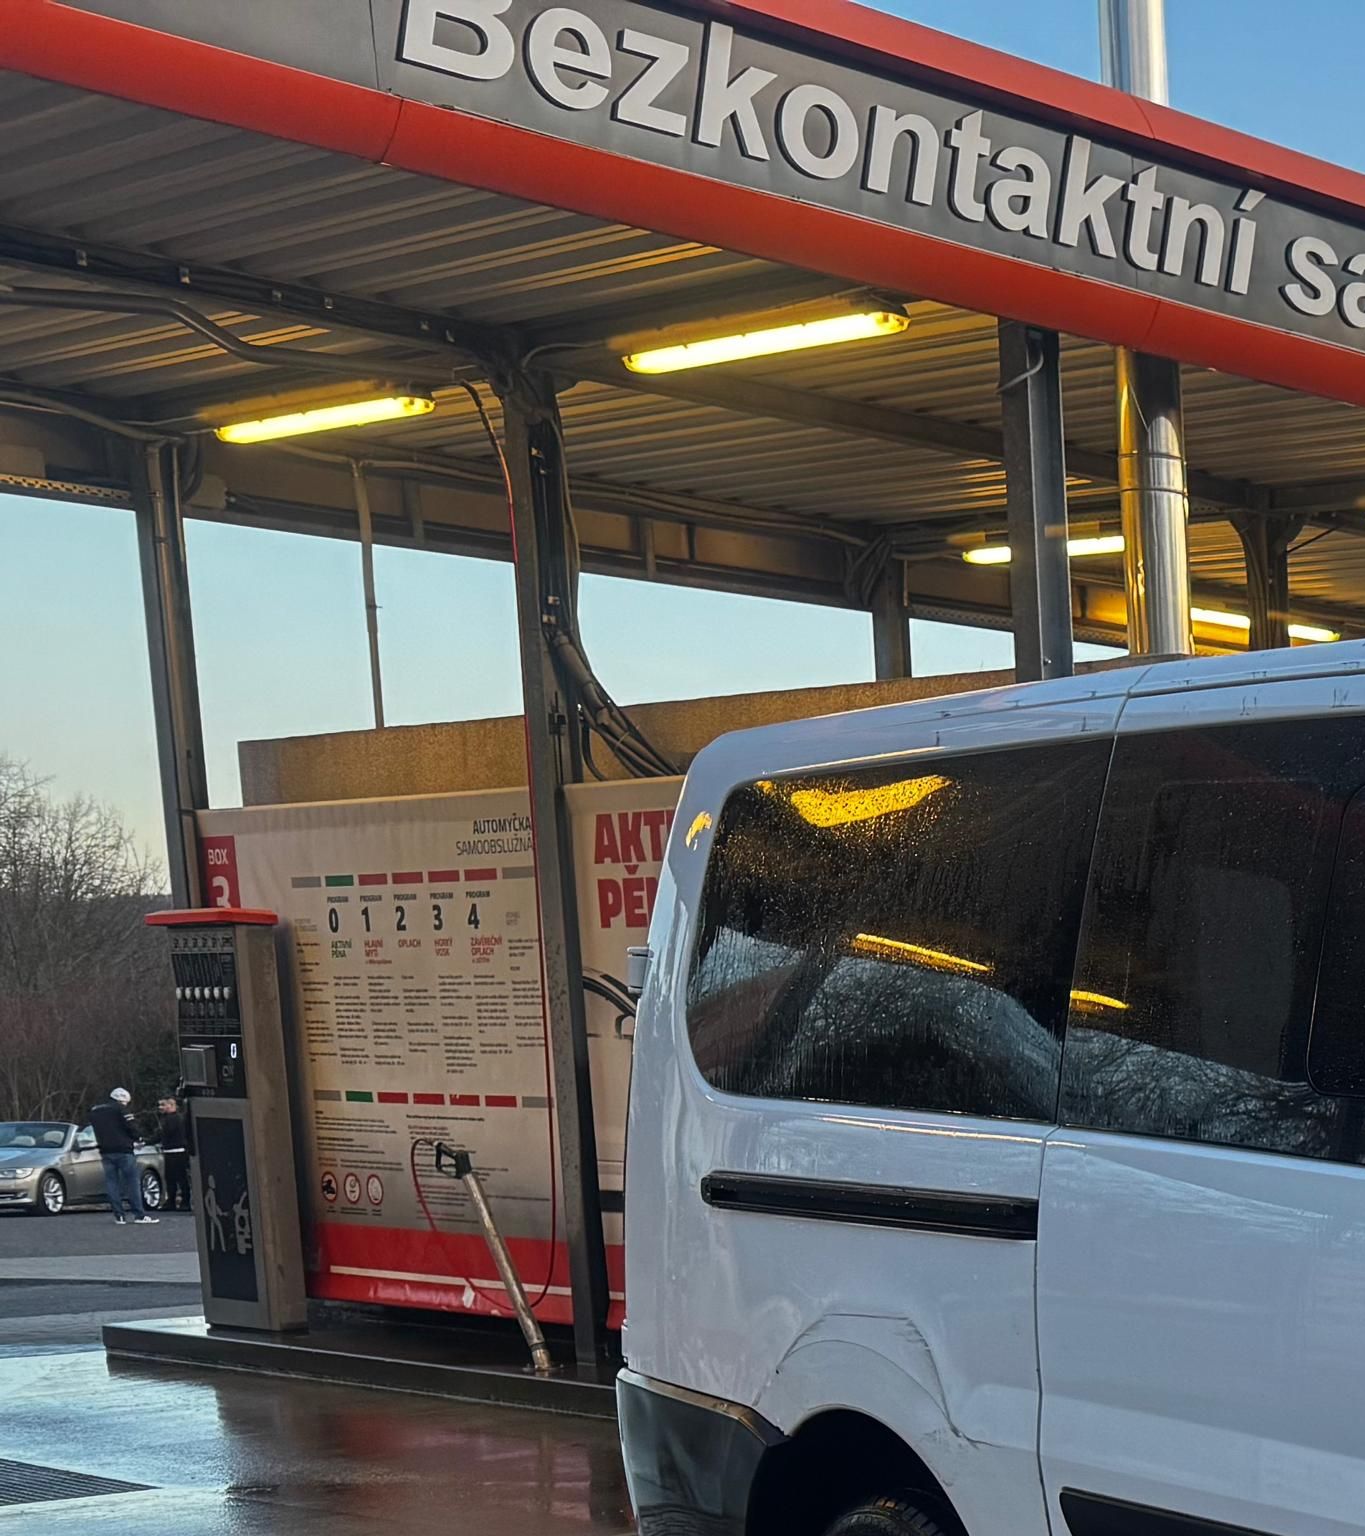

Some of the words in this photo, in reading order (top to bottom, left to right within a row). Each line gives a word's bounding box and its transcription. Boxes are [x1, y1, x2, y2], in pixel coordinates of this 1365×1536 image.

[397, 0, 1268, 296] Bezkontaktní
[473, 812, 532, 835] AUTOMYČKA
[208, 849, 229, 865] BOX
[455, 833, 533, 856] SAMOOBSLUŽNÁ
[329, 907, 339, 933] 0
[361, 906, 371, 932] 1
[395, 905, 407, 931] 2
[432, 904, 443, 930] 3
[467, 903, 480, 929] 4
